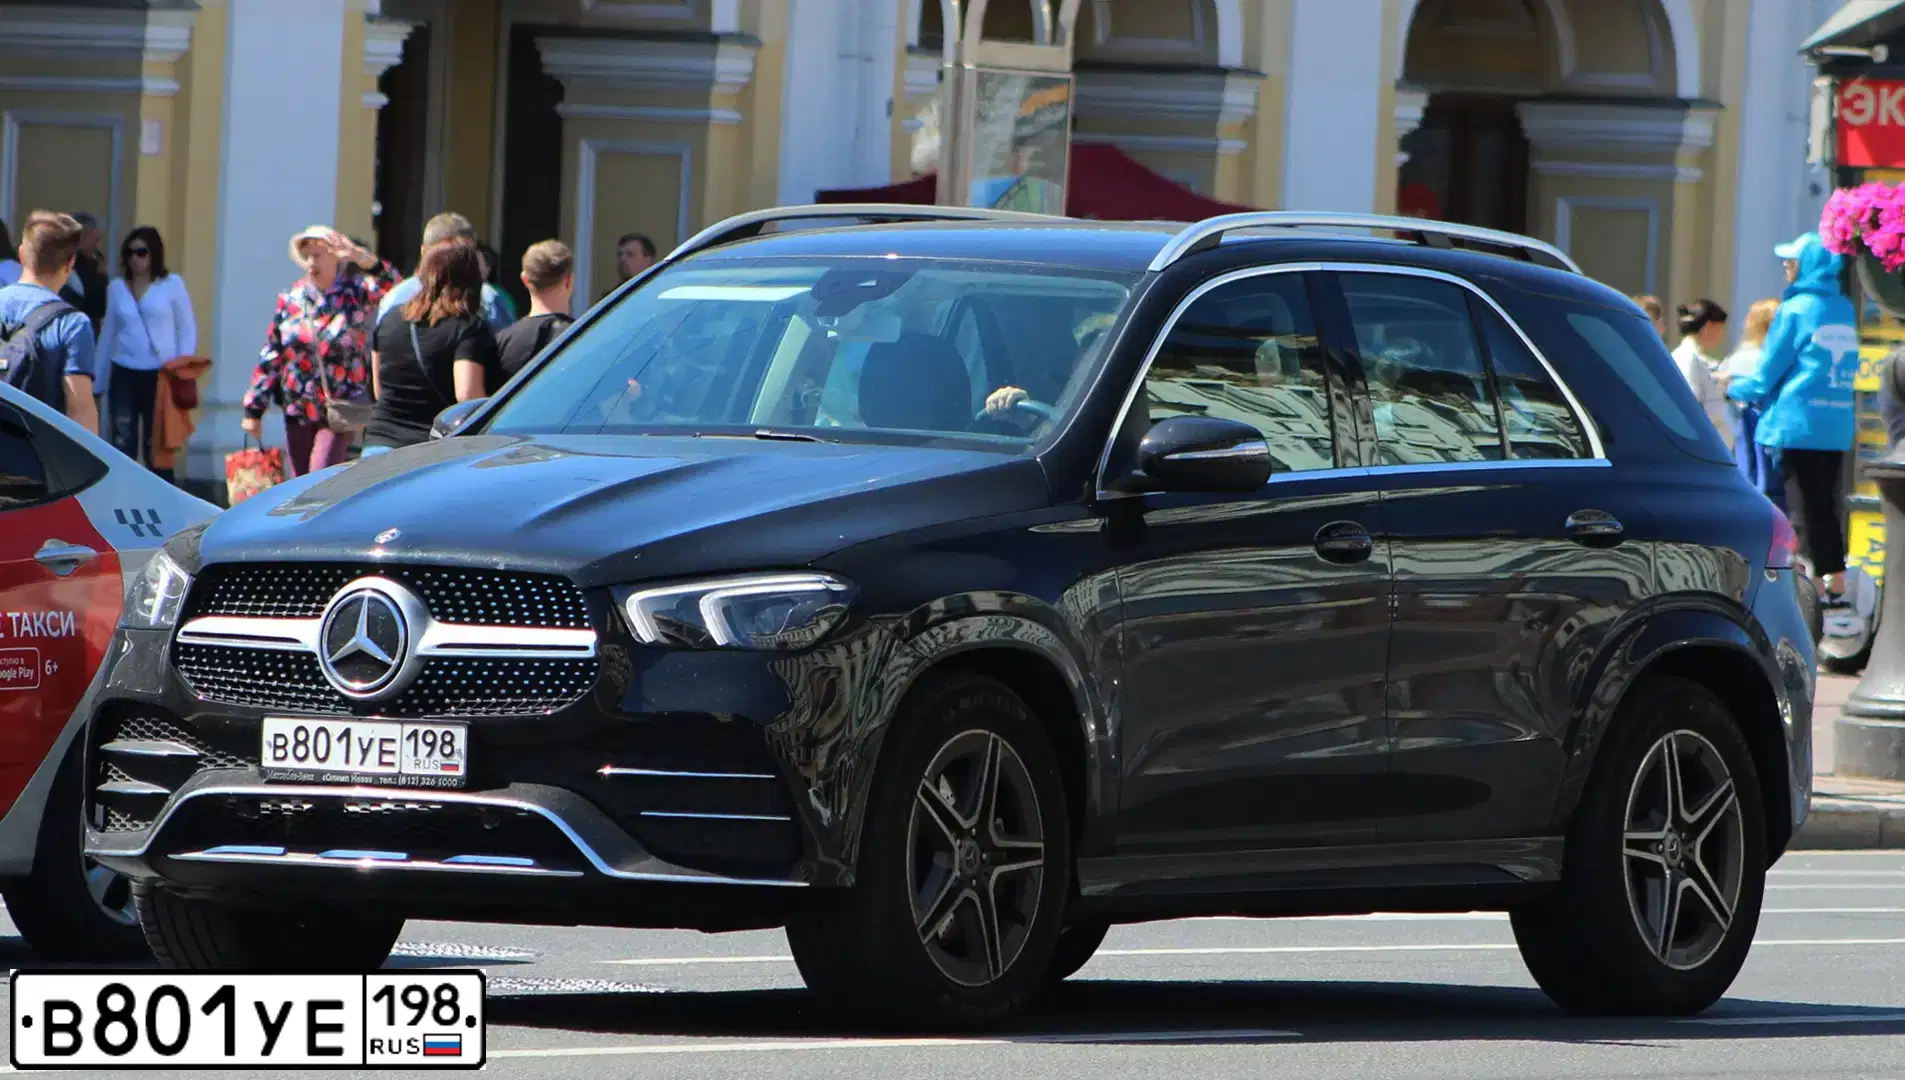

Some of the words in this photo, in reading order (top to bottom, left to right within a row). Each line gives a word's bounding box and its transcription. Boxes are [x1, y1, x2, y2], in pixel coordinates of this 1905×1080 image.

[7, 610, 76, 638] ТАКСИ
[18, 666, 34, 680] Play
[45, 659, 59, 675] 6+
[272, 725, 397, 767] В801УЕ
[405, 728, 456, 758] 198
[413, 759, 439, 771] RUS
[398, 775, 419, 786] (812)
[420, 777, 436, 786] 326
[437, 778, 458, 787] 1000
